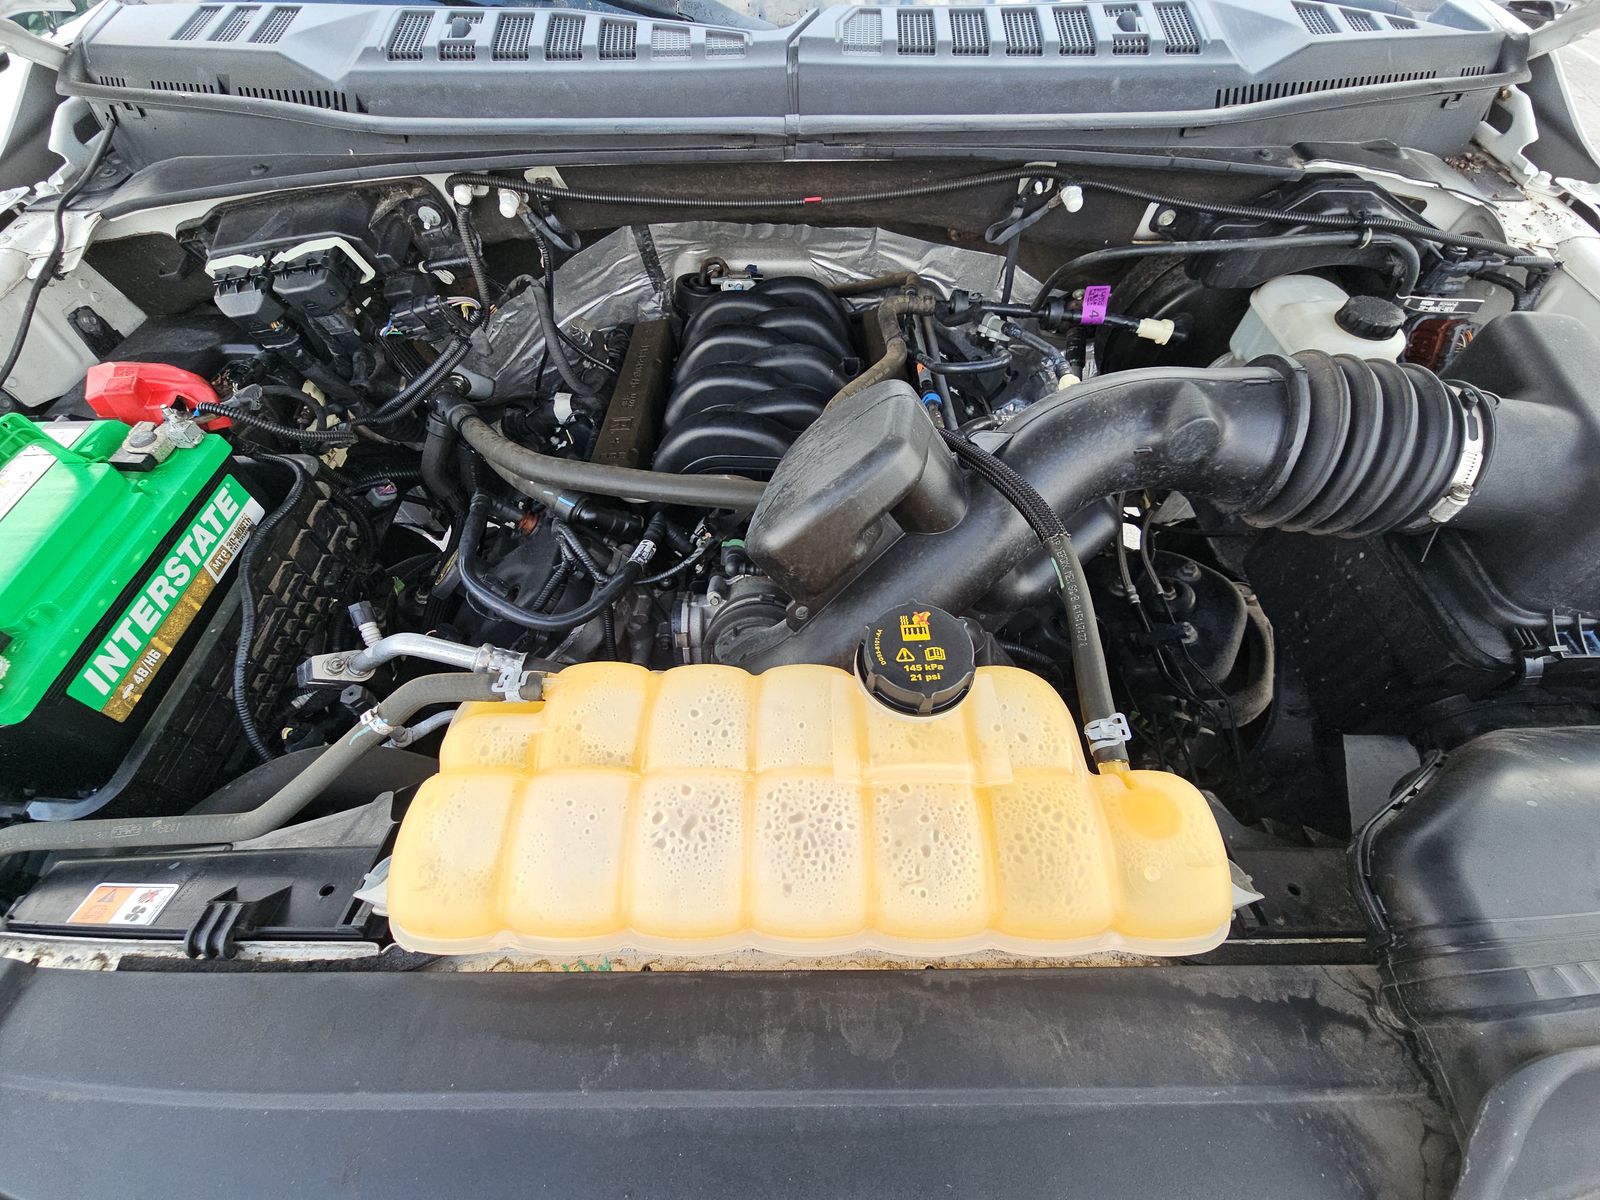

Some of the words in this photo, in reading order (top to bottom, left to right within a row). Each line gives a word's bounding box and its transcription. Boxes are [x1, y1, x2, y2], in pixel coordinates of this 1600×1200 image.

[212, 549, 228, 570] MTP
[84, 486, 239, 696] INTERSTATE
[133, 649, 162, 685] 48/H6
[903, 664, 923, 672] 145
[924, 663, 945, 671] kPa
[910, 673, 923, 682] 21
[925, 672, 941, 682] psi
